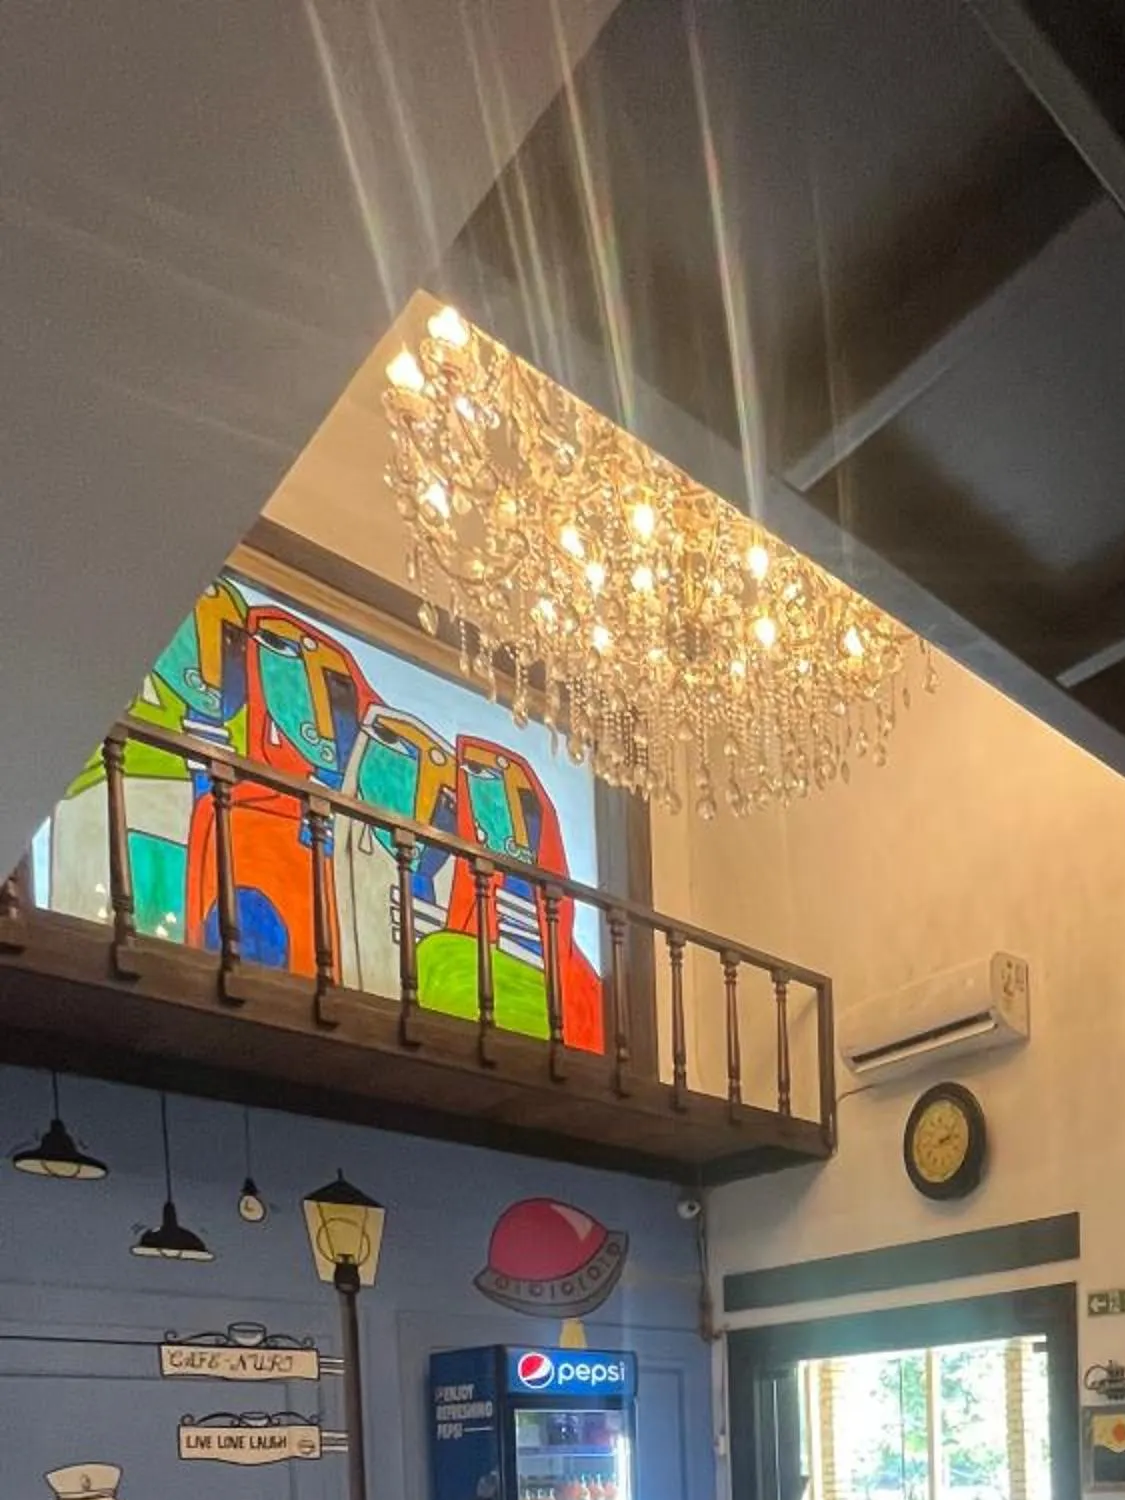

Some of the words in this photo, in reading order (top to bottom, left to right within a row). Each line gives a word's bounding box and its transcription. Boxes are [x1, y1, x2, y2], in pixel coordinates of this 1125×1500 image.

[557, 1361, 625, 1386] pepsi
[185, 1435, 212, 1449] LIVE
[217, 1435, 247, 1449] LOVE
[249, 1435, 287, 1449] LAUGH
